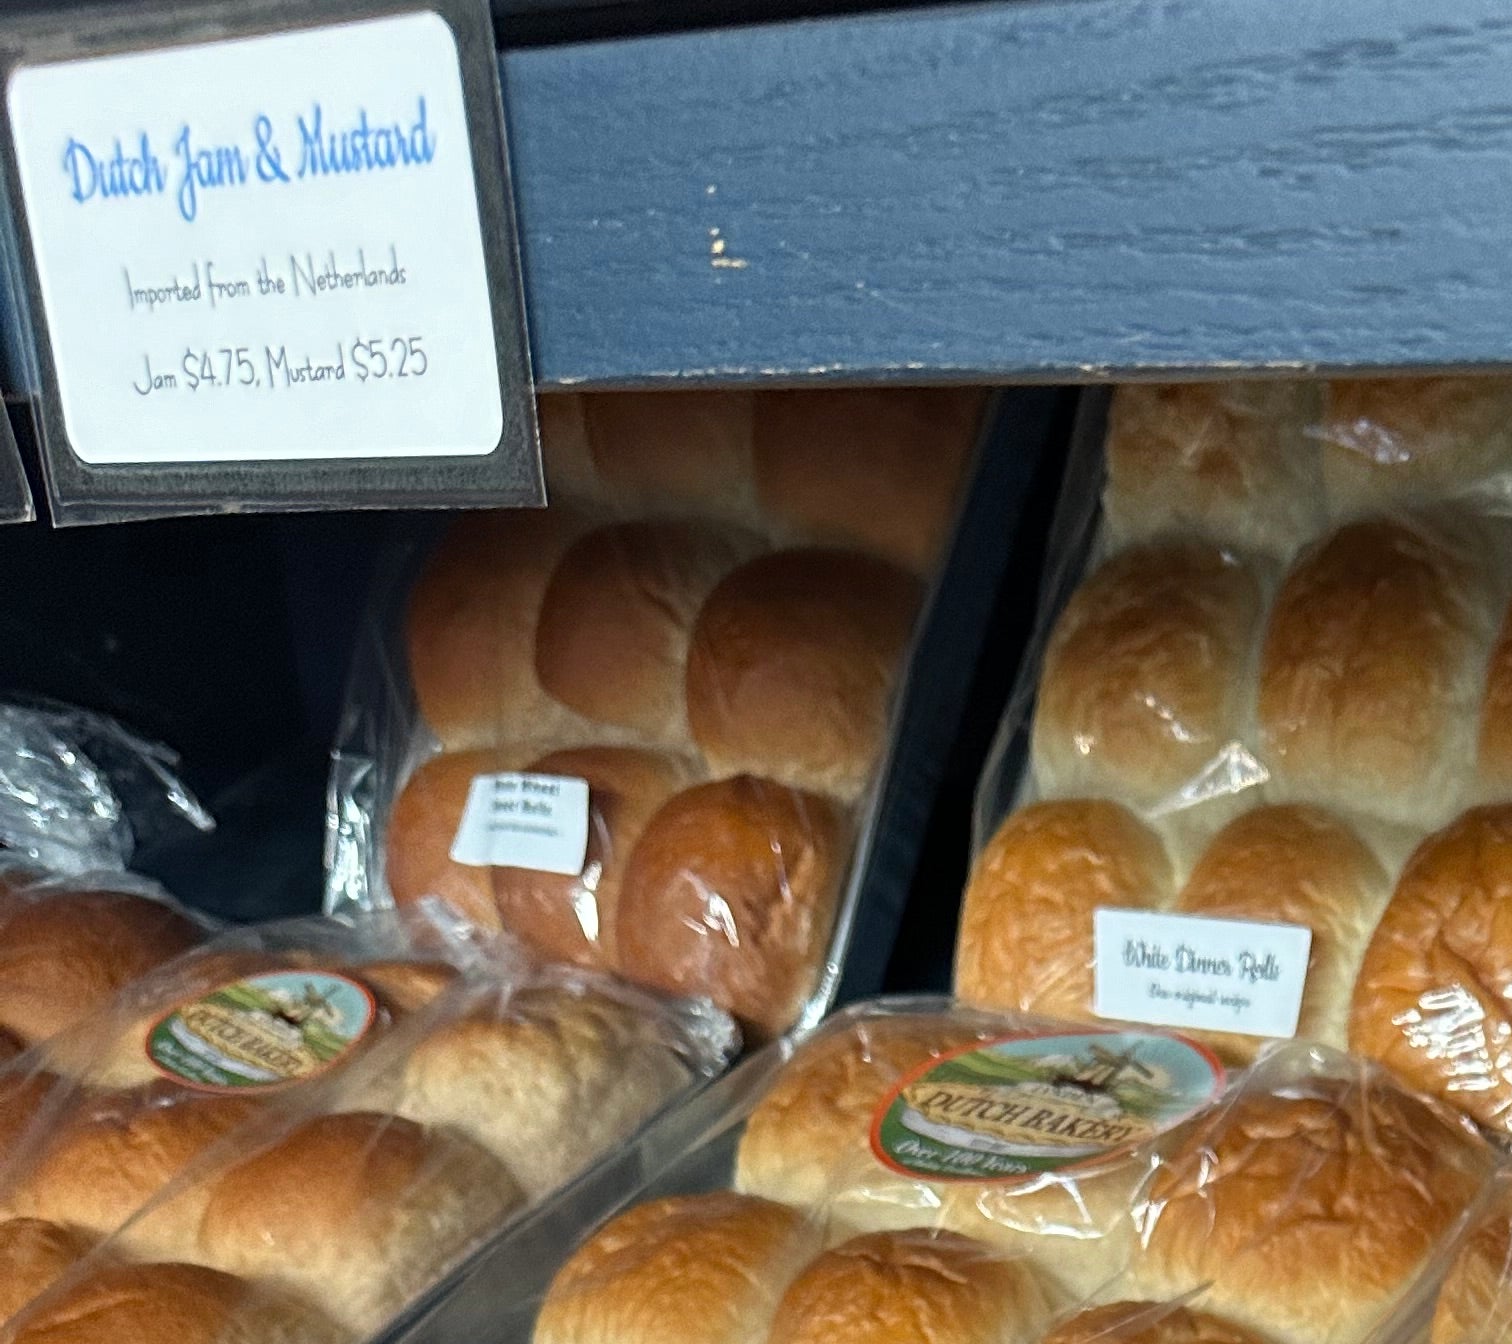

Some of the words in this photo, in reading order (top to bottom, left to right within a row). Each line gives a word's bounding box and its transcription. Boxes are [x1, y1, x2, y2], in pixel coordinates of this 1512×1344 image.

[65, 133, 166, 203] Dutch
[177, 123, 246, 222] Jam
[253, 115, 290, 183] &
[298, 95, 436, 179] Mustard
[123, 263, 201, 310] Imported
[207, 260, 250, 308] from
[258, 255, 285, 296] the
[290, 244, 407, 299] Netherlands
[133, 355, 177, 395] Jam
[266, 342, 345, 388] Mustard
[351, 335, 428, 382] $5.25
[928, 1091, 1022, 1129] DUTCH
